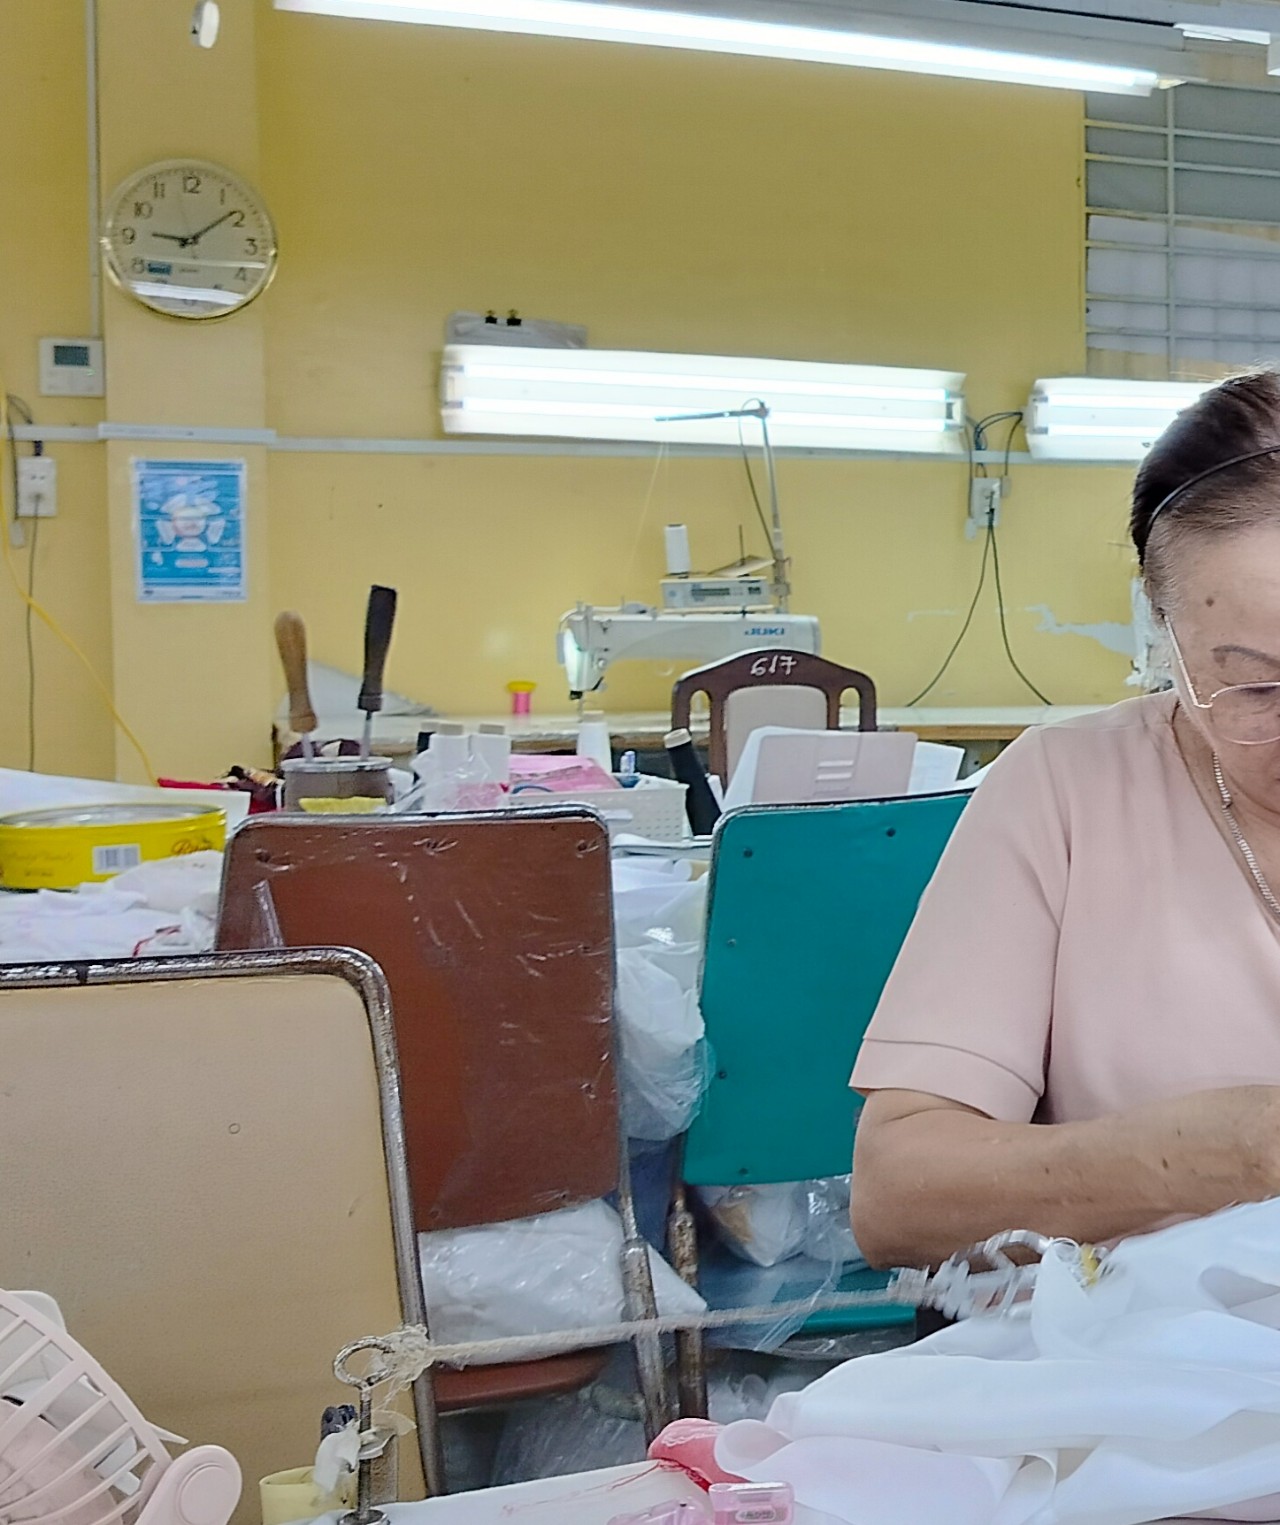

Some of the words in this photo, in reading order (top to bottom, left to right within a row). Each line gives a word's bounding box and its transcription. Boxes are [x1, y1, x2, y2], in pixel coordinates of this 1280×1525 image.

[153, 181, 165, 199] 11
[183, 176, 201, 194] 12
[219, 188, 226, 206] 1
[134, 201, 153, 219] 10
[232, 209, 246, 228] 2
[122, 227, 136, 245] 9
[245, 238, 258, 256] 3
[234, 266, 247, 282] 4
[750, 655, 797, 676] 617
